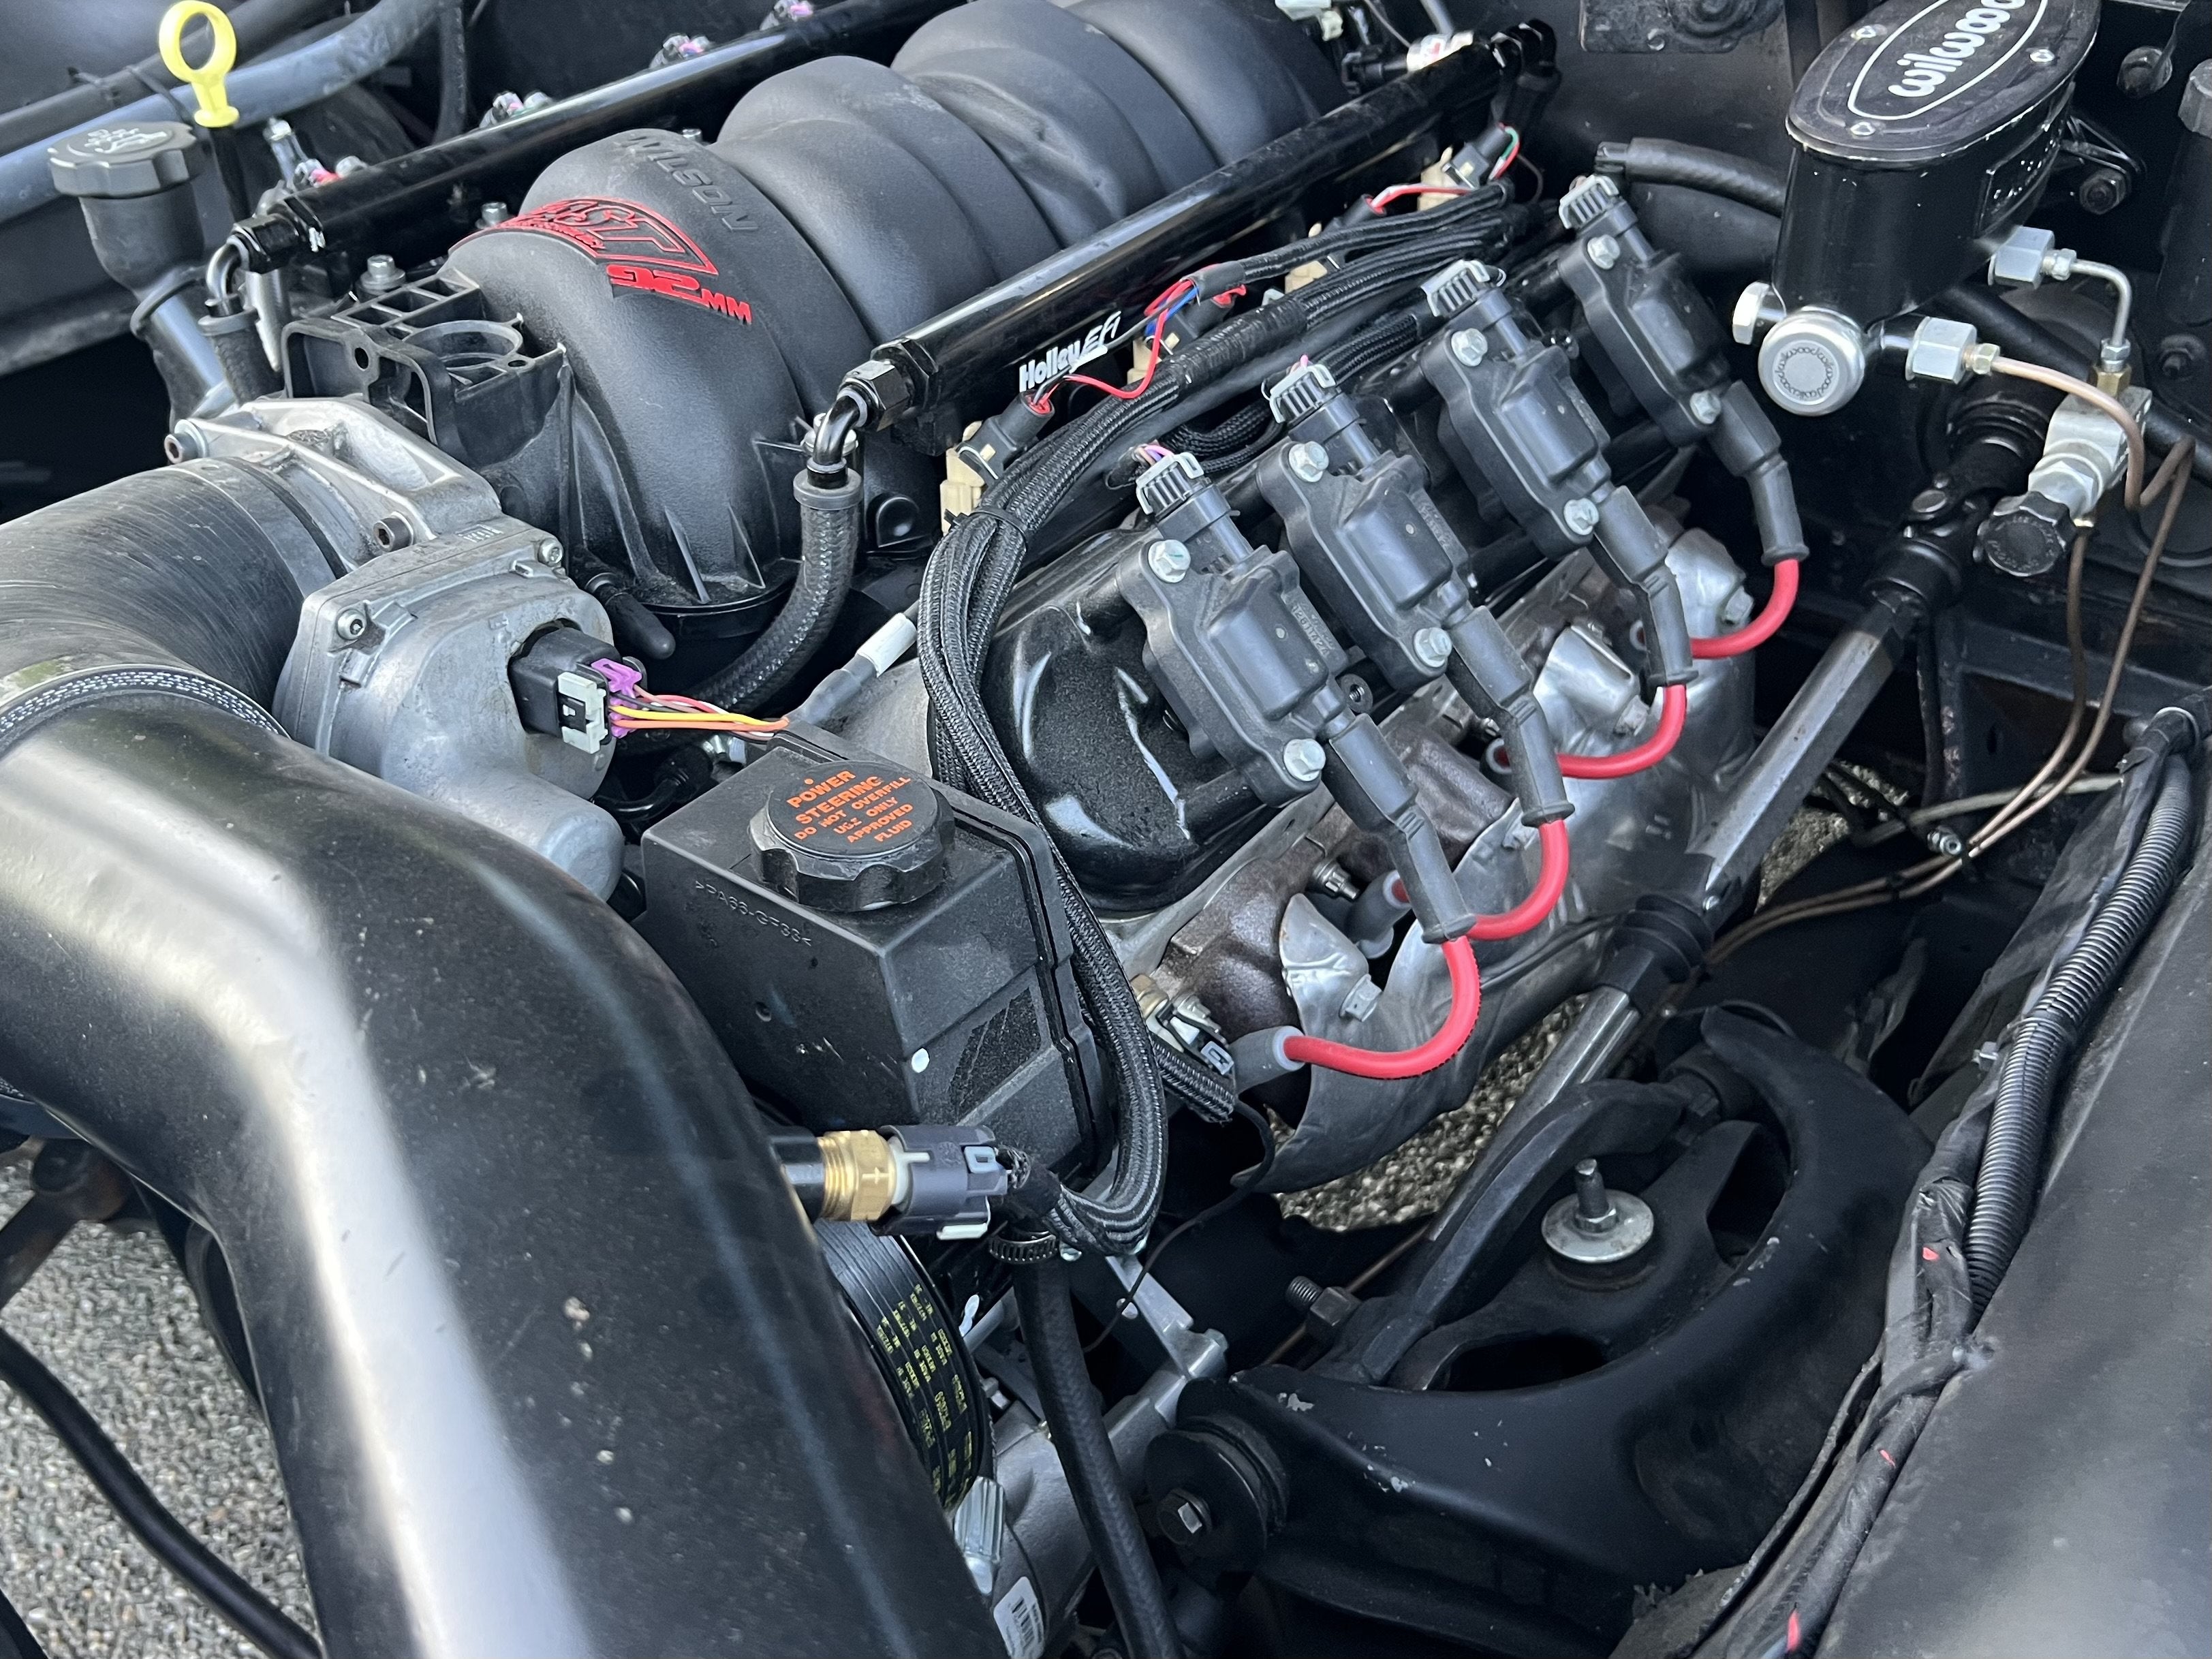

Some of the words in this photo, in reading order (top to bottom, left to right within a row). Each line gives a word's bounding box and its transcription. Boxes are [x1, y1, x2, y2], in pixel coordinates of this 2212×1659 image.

[614, 136, 759, 231] WILSON
[1019, 340, 1082, 392] Holley
[786, 771, 856, 808] POWER
[794, 826, 817, 840] DO
[819, 809, 847, 827] NOT
[851, 776, 912, 809] OVERFILL
[795, 776, 884, 824] STEERING
[866, 796, 899, 817] ONLY
[846, 804, 914, 843] APPROVED
[873, 820, 913, 842] FLUID
